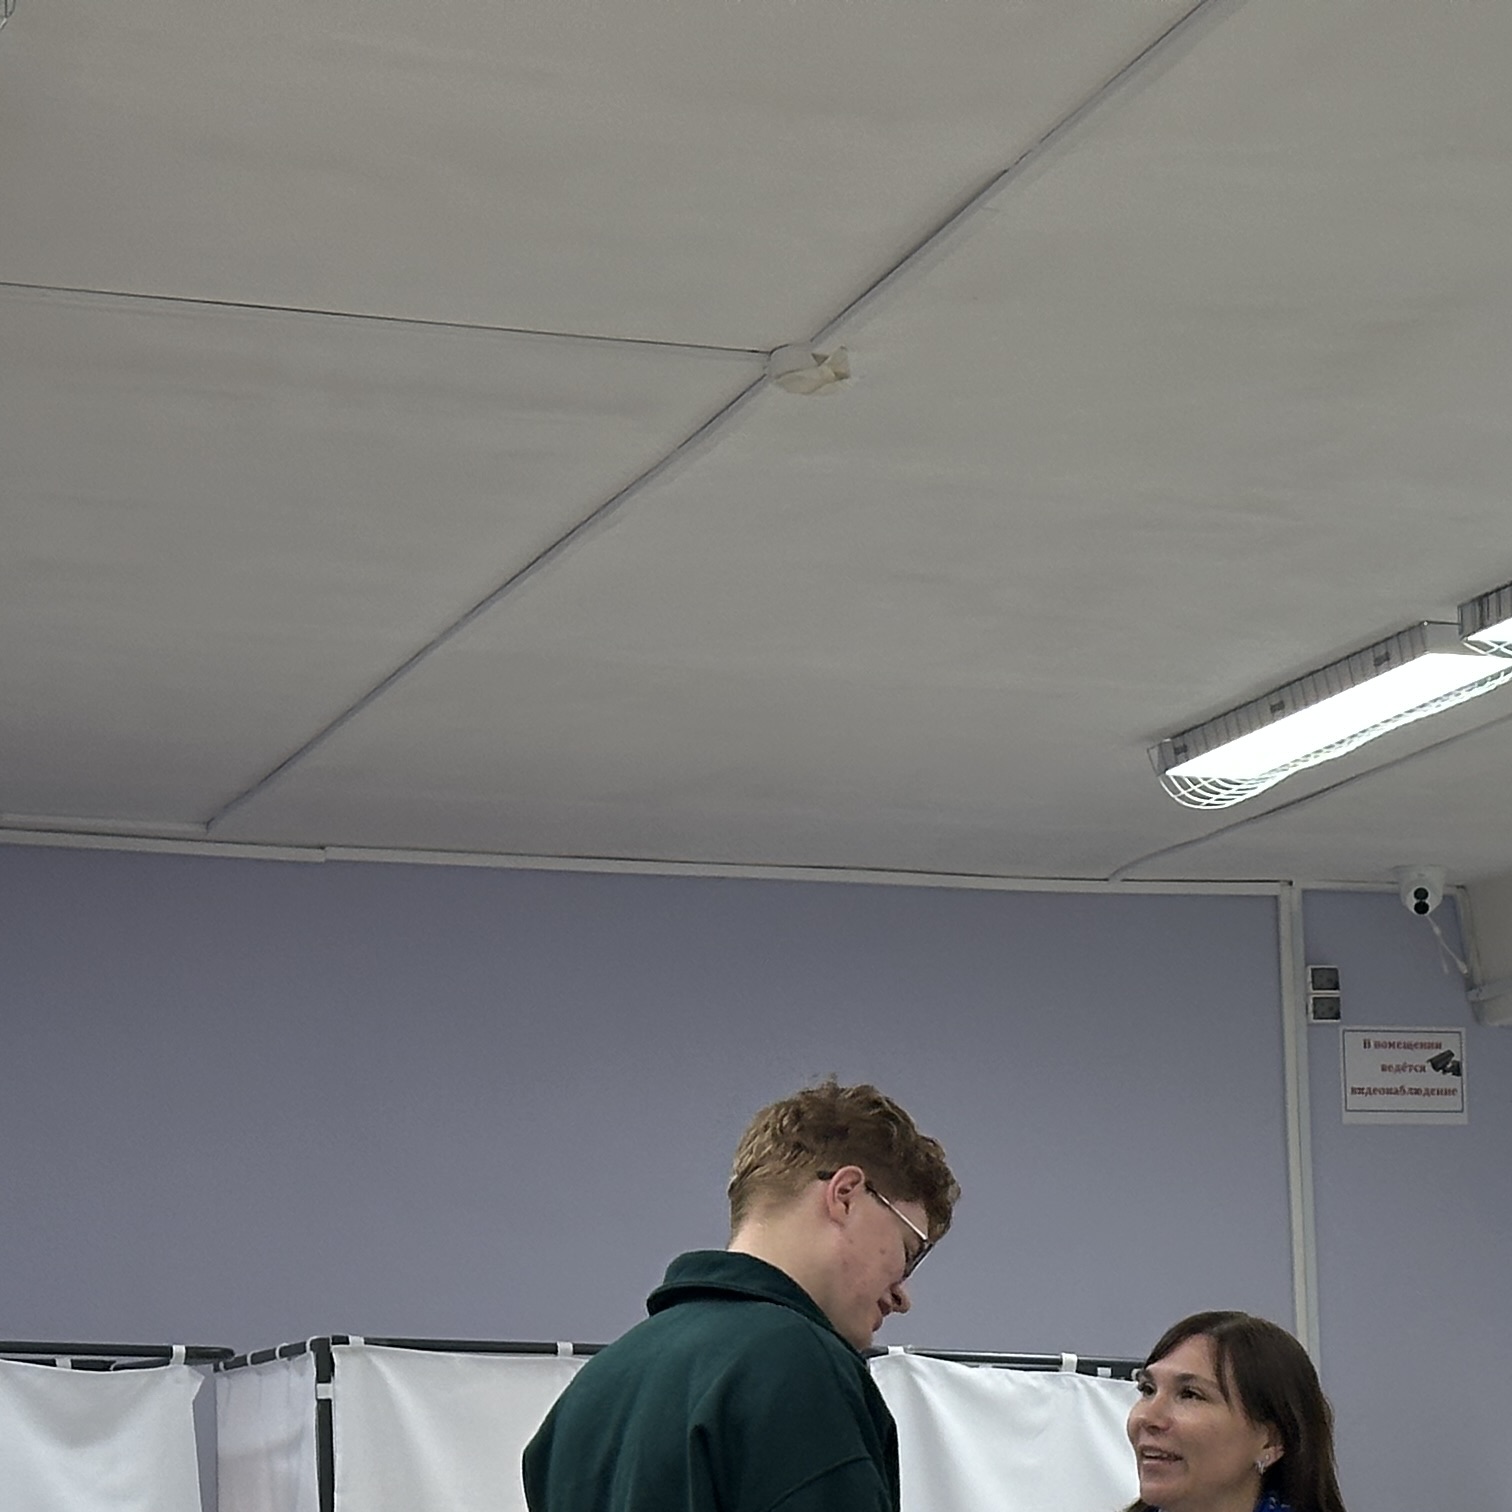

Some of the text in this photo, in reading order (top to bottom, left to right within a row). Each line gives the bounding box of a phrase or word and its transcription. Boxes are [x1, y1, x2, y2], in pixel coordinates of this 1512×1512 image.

[1363, 1038, 1443, 1052] В помещении
[1380, 1062, 1427, 1074] ведётся
[1351, 1086, 1458, 1097] видеонаблюдение
